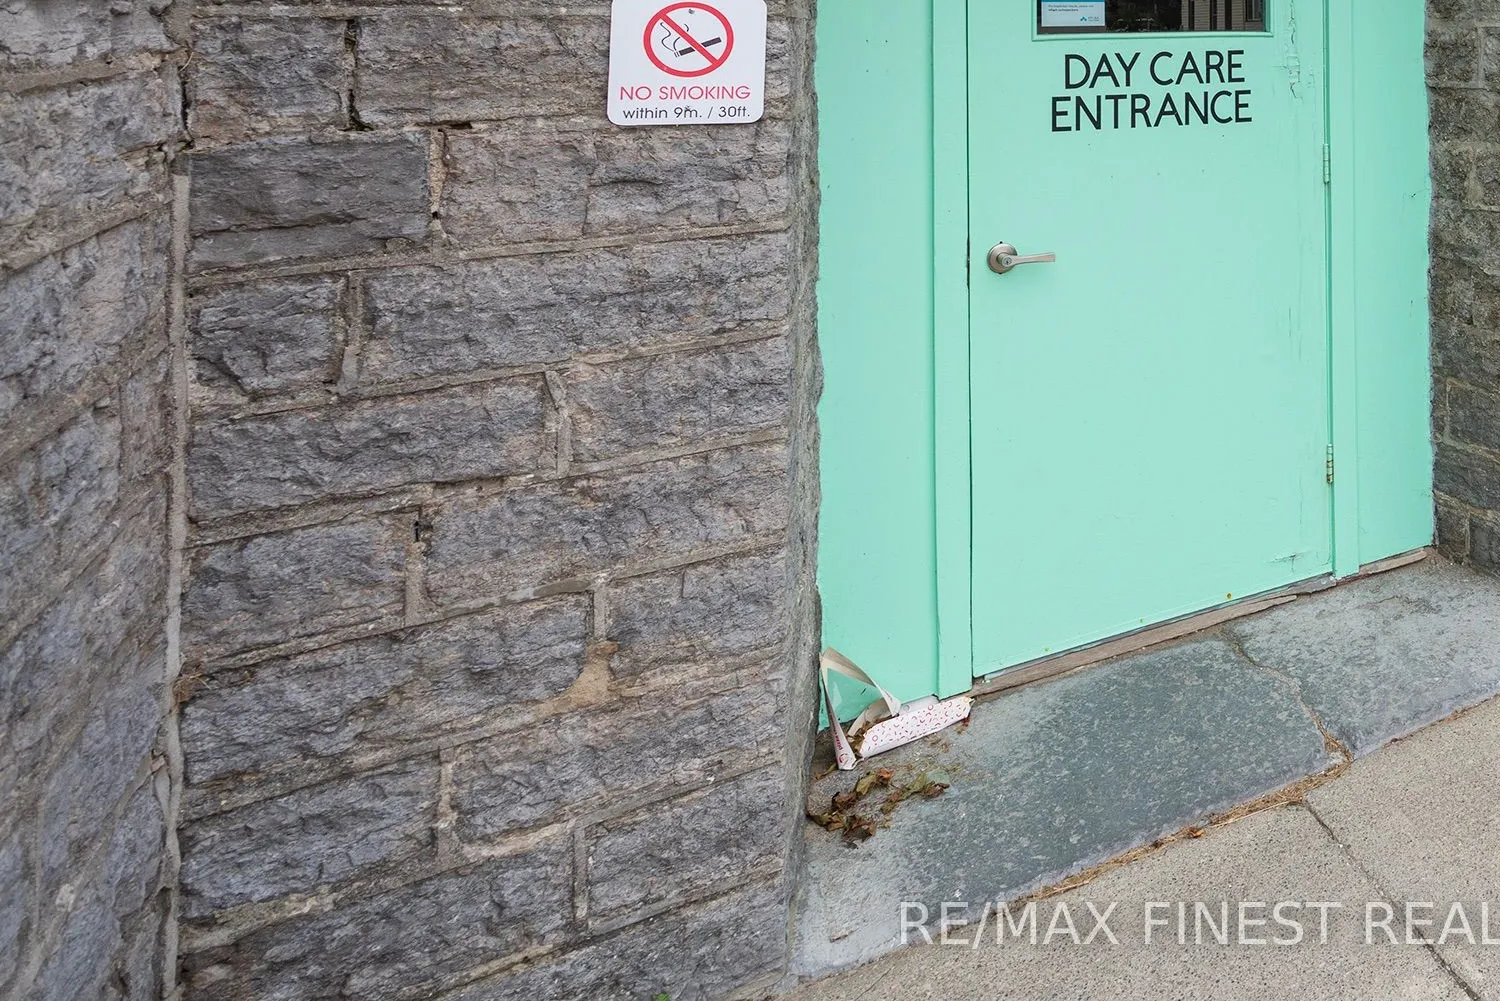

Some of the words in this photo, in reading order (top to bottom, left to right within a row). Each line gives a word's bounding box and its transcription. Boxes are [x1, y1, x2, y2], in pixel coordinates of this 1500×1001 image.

[1064, 51, 1141, 90] DAY
[1149, 49, 1246, 86] CARE
[620, 86, 652, 101] NO
[659, 85, 751, 100] SMOKING
[622, 107, 668, 119] within
[674, 106, 702, 118] 9m.
[707, 106, 714, 119] /
[718, 105, 751, 118] 30ft.
[1051, 89, 1253, 133] ENTRANCE
